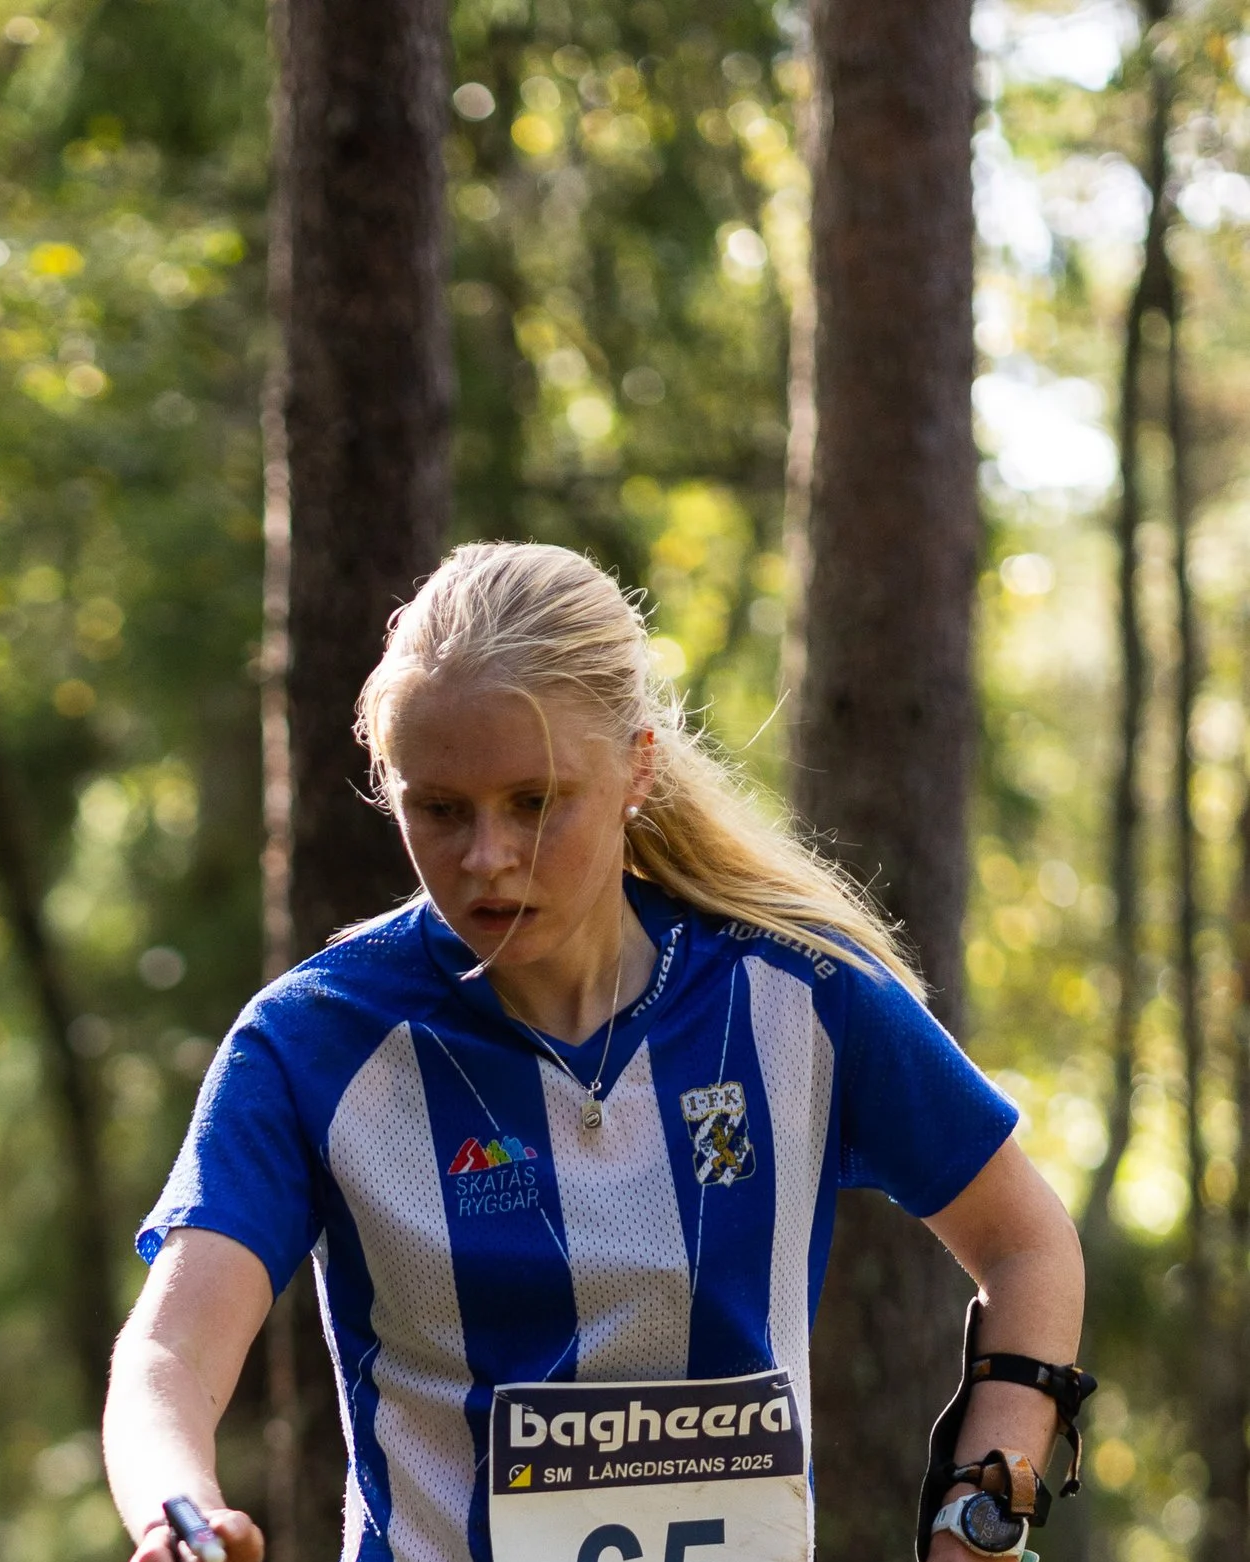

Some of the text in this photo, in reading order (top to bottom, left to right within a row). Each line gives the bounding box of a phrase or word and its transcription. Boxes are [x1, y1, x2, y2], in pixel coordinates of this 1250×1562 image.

[456, 1163, 536, 1195] SKATÅS
[459, 1188, 539, 1216] RYGGAR
[510, 1396, 792, 1452] bagheera
[543, 1454, 774, 1484] SM LÅNGDISTANS 2025
